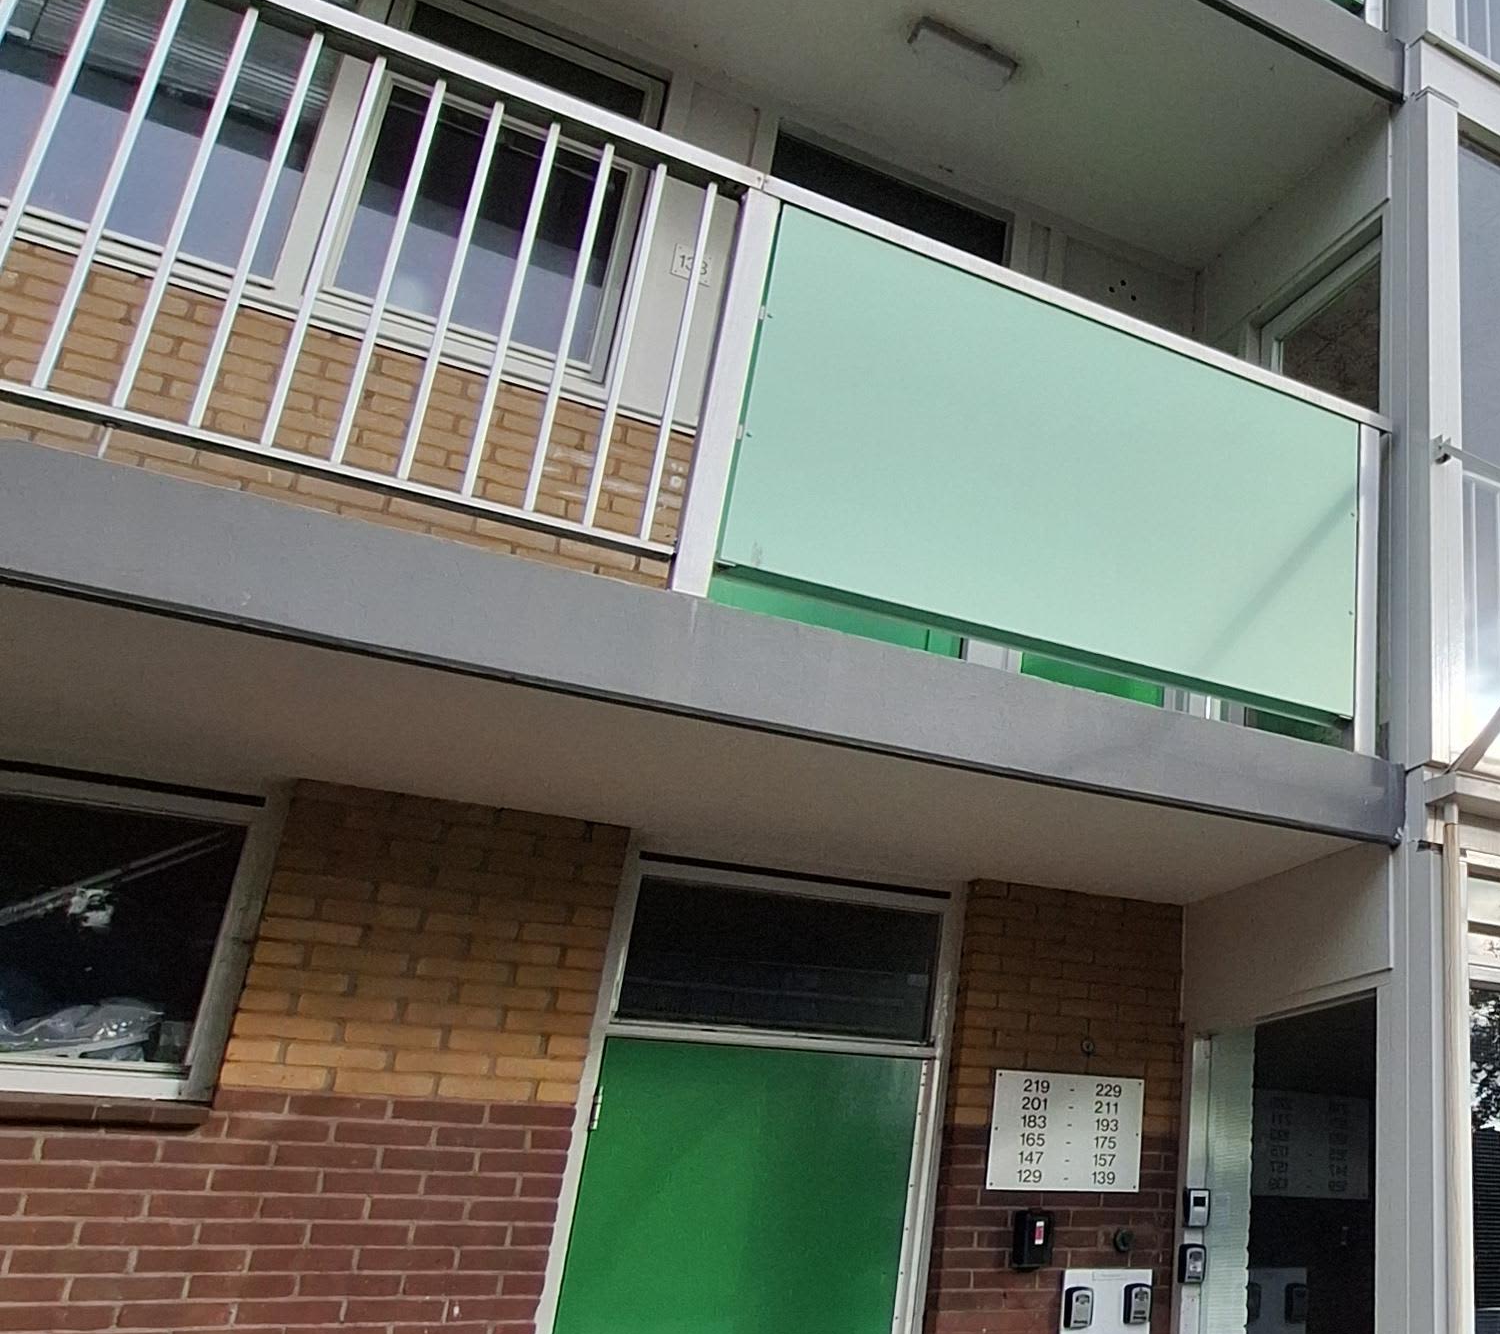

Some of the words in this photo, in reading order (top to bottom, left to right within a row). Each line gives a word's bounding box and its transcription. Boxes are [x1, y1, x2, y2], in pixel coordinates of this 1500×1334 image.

[1023, 1078, 1050, 1094] 219
[1095, 1083, 1122, 1098] 229
[1021, 1096, 1048, 1111] 201
[1094, 1100, 1119, 1115] 211
[1020, 1114, 1047, 1129] 183
[1095, 1118, 1119, 1132] 193
[1019, 1132, 1045, 1147] 165
[1094, 1136, 1117, 1149] 175
[1018, 1150, 1044, 1165] 147
[1093, 1153, 1116, 1167] 157
[1016, 1169, 1042, 1183] 129
[1092, 1171, 1116, 1185] 139
